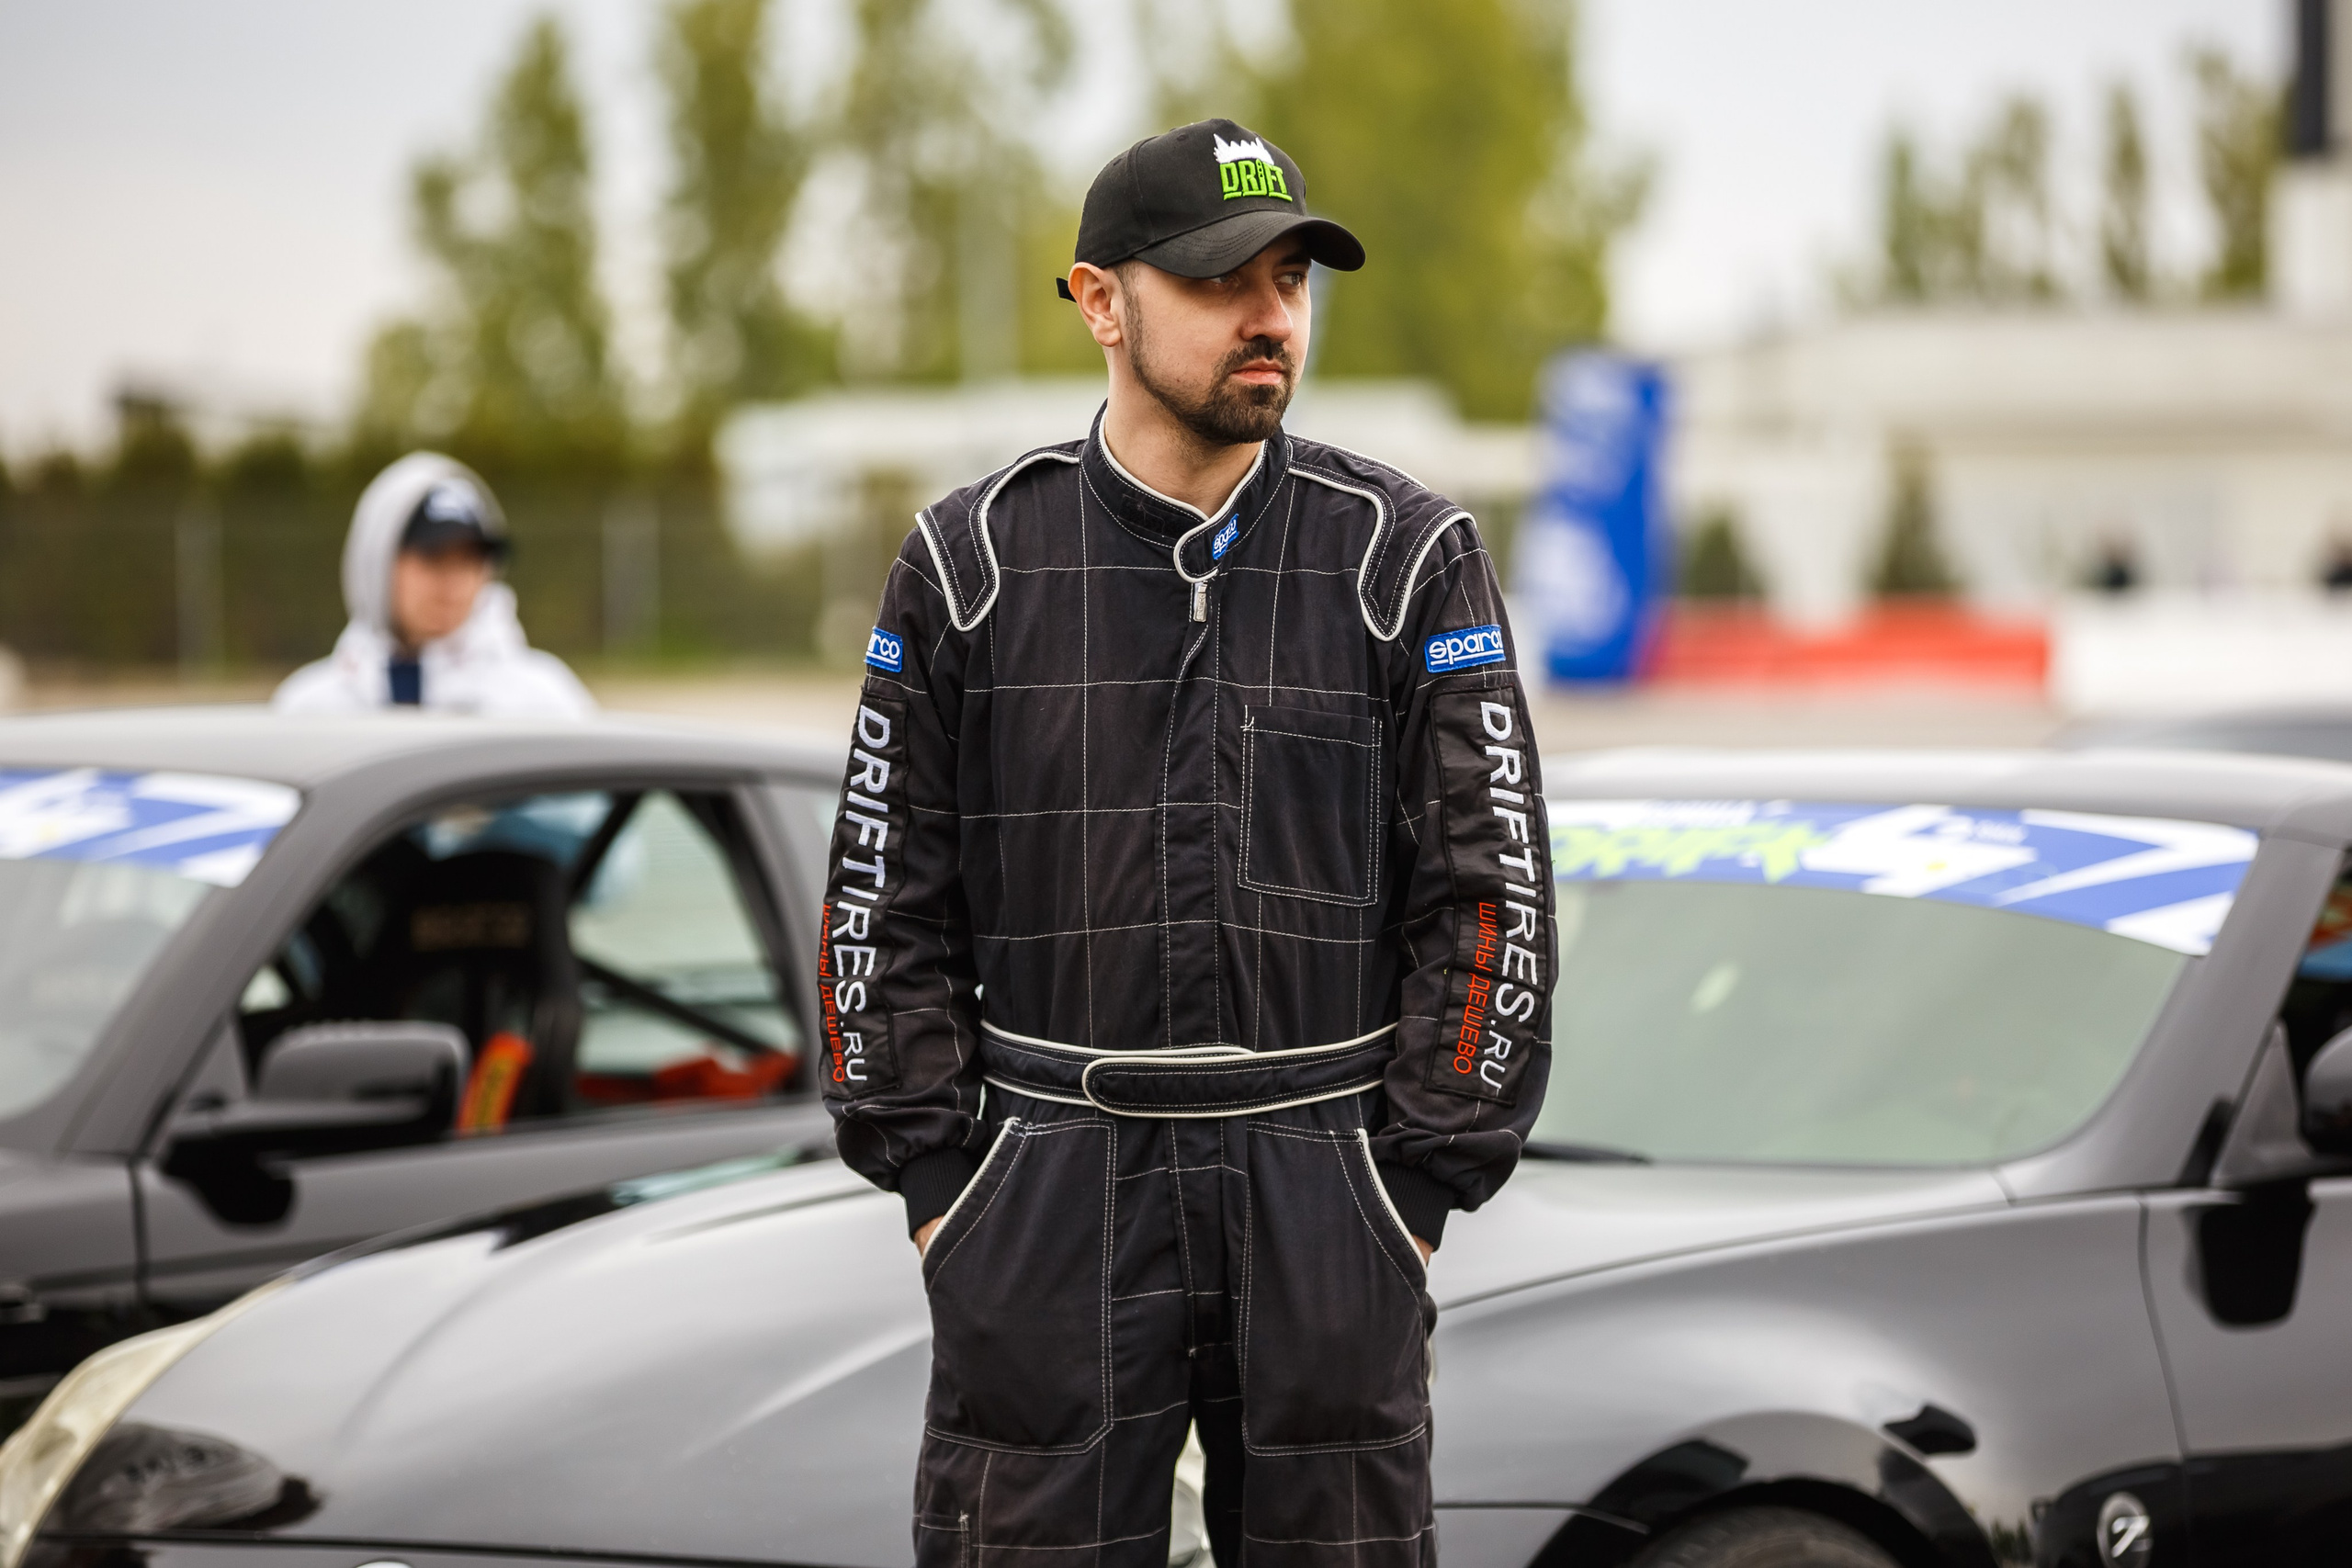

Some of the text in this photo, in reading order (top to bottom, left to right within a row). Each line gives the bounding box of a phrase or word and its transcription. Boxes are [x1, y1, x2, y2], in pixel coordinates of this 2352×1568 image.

[1219, 158, 1293, 201] DRIFT
[831, 705, 890, 1081] DRIFTIRES.RU
[1479, 700, 1538, 1090] DRIFTIRES.RU
[820, 984, 844, 1083] ДЕШЕВО
[1453, 902, 1498, 1074] ШИНЫ ДЕШЕВО
